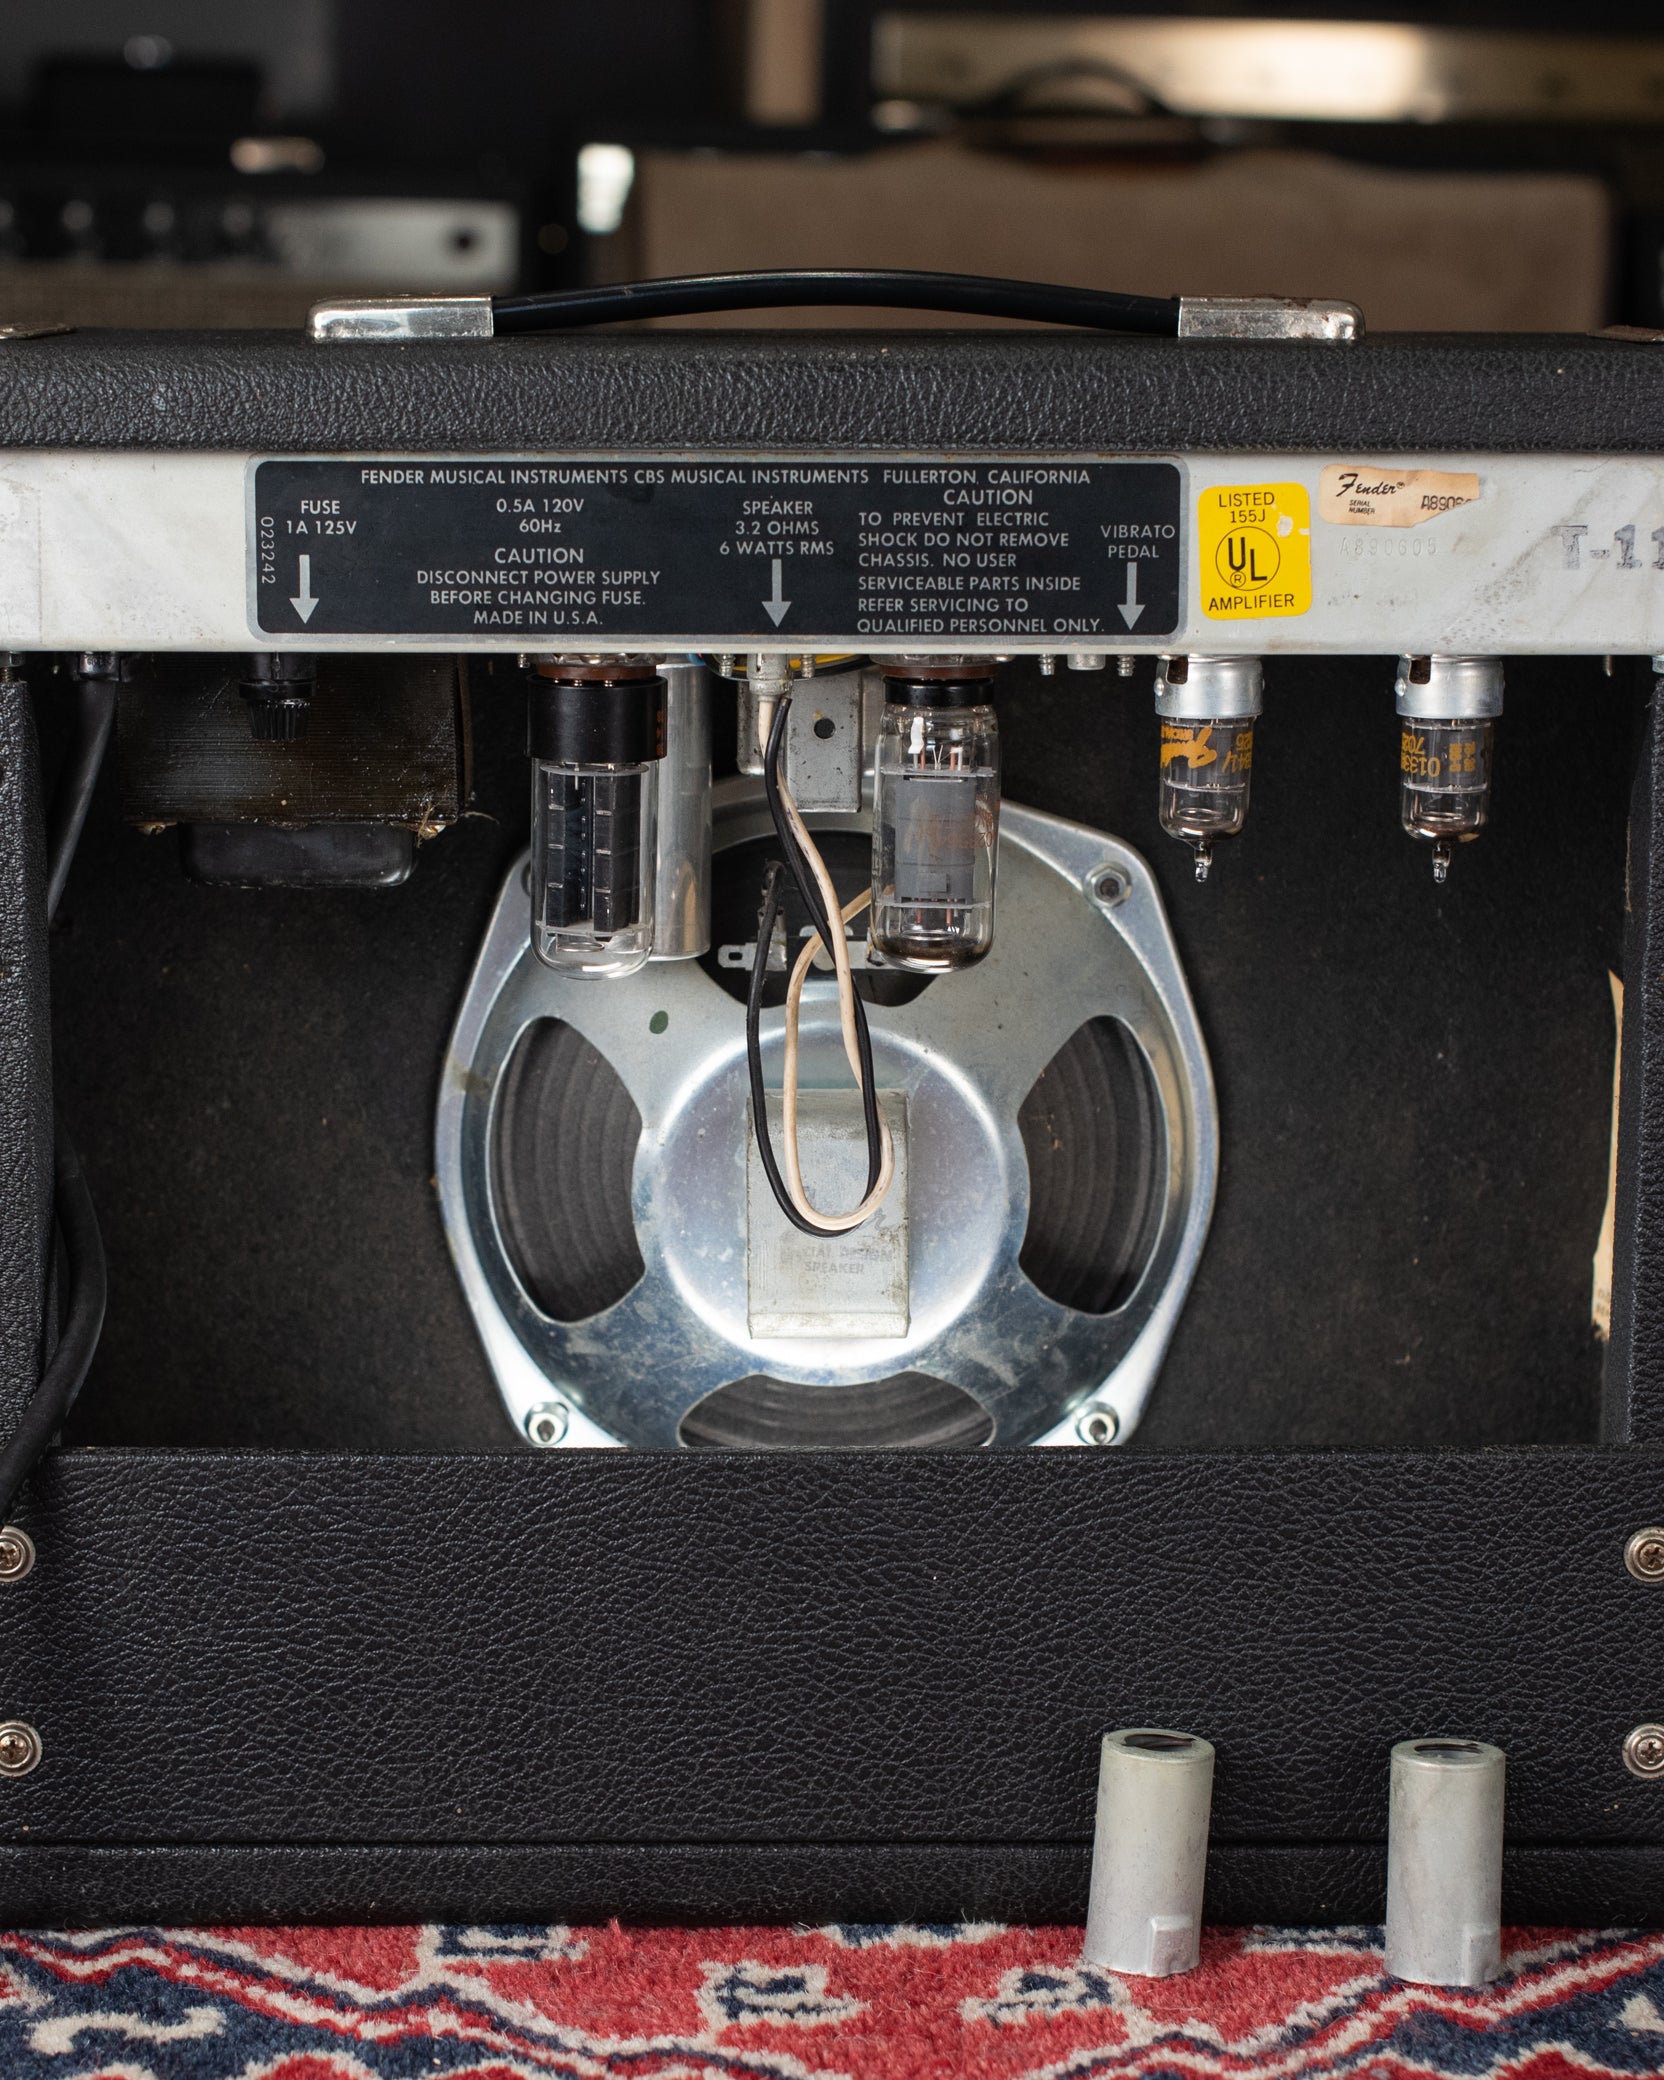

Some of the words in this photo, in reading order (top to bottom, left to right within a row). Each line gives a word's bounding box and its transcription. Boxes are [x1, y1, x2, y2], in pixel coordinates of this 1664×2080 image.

[362, 470, 424, 484] FENDER
[430, 470, 505, 484] MUSICAL
[511, 470, 627, 484] INSTRUMENTS
[634, 470, 664, 484] CBS
[671, 470, 746, 484] MUSICAL
[752, 470, 868, 483] INSTRUMENTS
[988, 470, 1090, 484] CALIFORNIA
[944, 489, 1032, 505] CAUTION
[1219, 492, 1274, 508] LISTED
[1421, 495, 1472, 512] A890
[301, 500, 340, 514] FUSE
[497, 499, 535, 512] 0.5A
[544, 499, 584, 512] 120V
[743, 501, 812, 515] SPEAKER
[1348, 507, 1376, 515] NUMBER
[859, 512, 881, 526] TO
[894, 512, 964, 526] PREVENT
[977, 512, 1048, 526] ELECTRIC
[1230, 509, 1266, 524] 155J
[287, 520, 308, 534] 1A
[316, 521, 356, 534] 125V
[519, 519, 561, 533] 60Hz
[736, 521, 760, 534] 3.2
[767, 521, 819, 535] OHMS
[1101, 525, 1175, 538] VIBRATO
[859, 533, 917, 546] SHOCK
[925, 533, 949, 546] DO
[957, 533, 993, 546] NOT
[1000, 533, 1068, 547] REMOVE
[260, 516, 276, 585] 023242
[720, 541, 729, 555] 6
[737, 541, 794, 555] WATTS
[800, 541, 833, 555] RMS
[1108, 545, 1159, 558] PEDAL
[495, 548, 583, 563] CAUTION
[859, 553, 933, 567] CHASSIS.
[943, 553, 970, 567] NO
[977, 553, 1016, 567] USER
[417, 570, 528, 584] DISCONNECT
[534, 571, 595, 584] POWER
[602, 571, 660, 585] SUPPLY
[859, 577, 963, 590] SERVICEABLE
[970, 577, 1019, 590] PARTS
[1026, 577, 1080, 590] INSIDE
[431, 591, 491, 604] BEFORE
[498, 591, 596, 604] CHANGING
[603, 591, 645, 605] FUSE.
[859, 598, 903, 611] REFER
[911, 598, 999, 612] SERVICING
[1006, 598, 1028, 612] TO
[1209, 593, 1294, 612] AMPLIFIER
[474, 611, 522, 624] MADE
[530, 611, 547, 624] IN
[554, 611, 602, 624] U.S.A.
[857, 619, 944, 632] QUALIFIED
[950, 619, 1047, 632] PERSONNEL
[1054, 618, 1104, 632] ONLY.
[804, 1261, 865, 1275] SPEAKER
